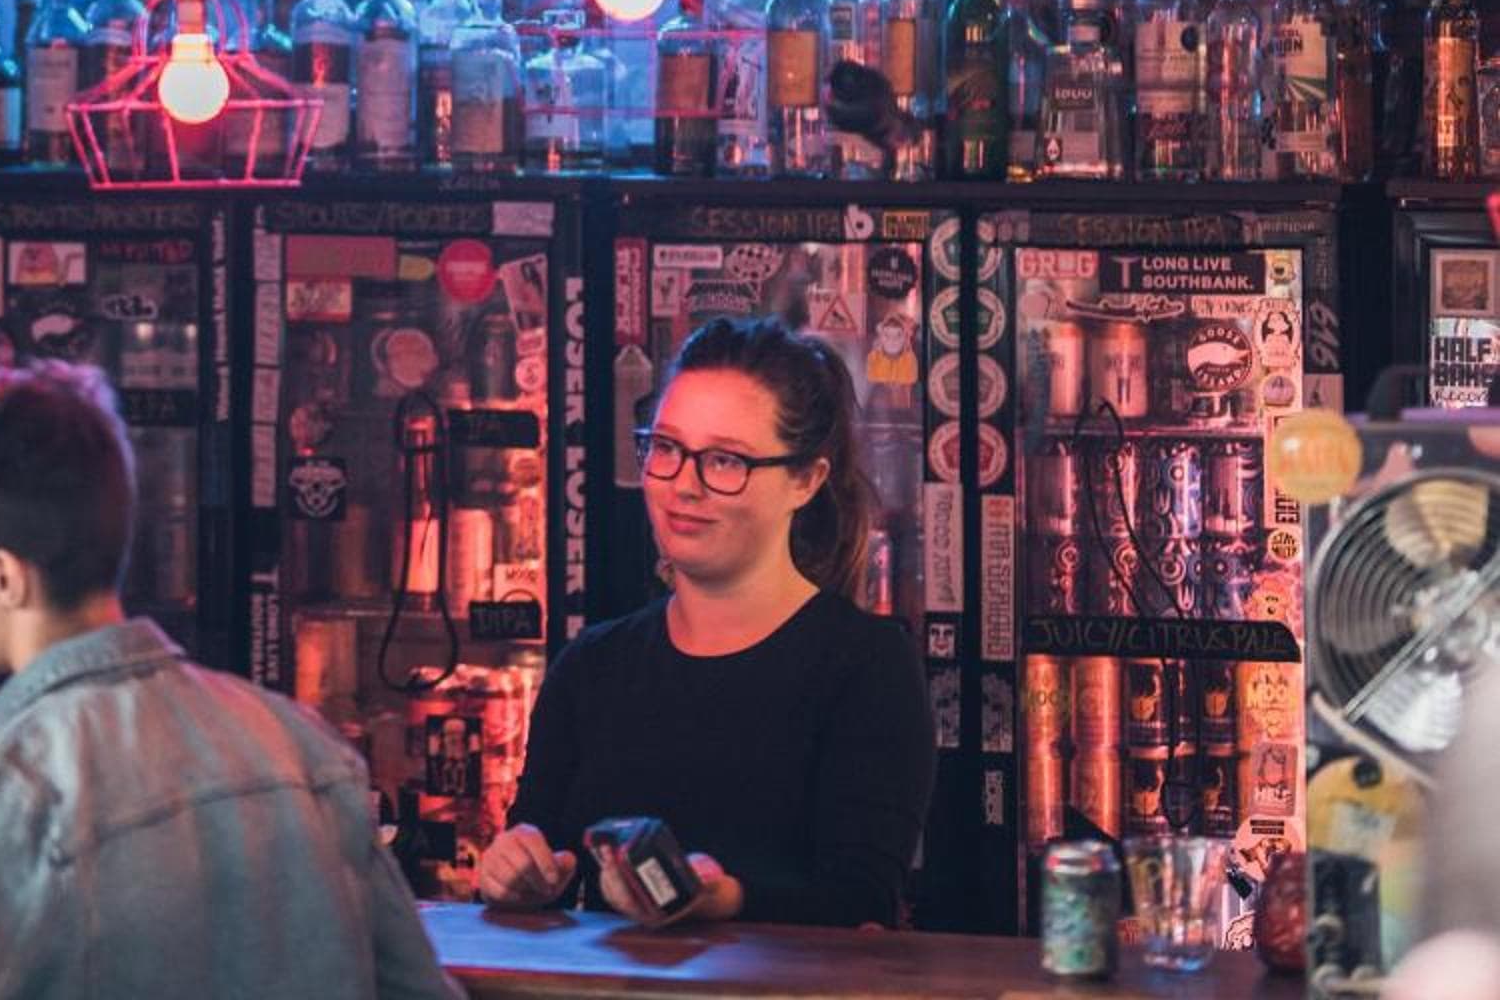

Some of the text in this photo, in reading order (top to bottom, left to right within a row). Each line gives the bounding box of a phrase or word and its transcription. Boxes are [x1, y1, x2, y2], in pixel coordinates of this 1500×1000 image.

[1142, 256, 1233, 272] LONG LIVE
[1141, 275, 1255, 291] SOUTHBANK.
[1433, 336, 1492, 363] HALF
